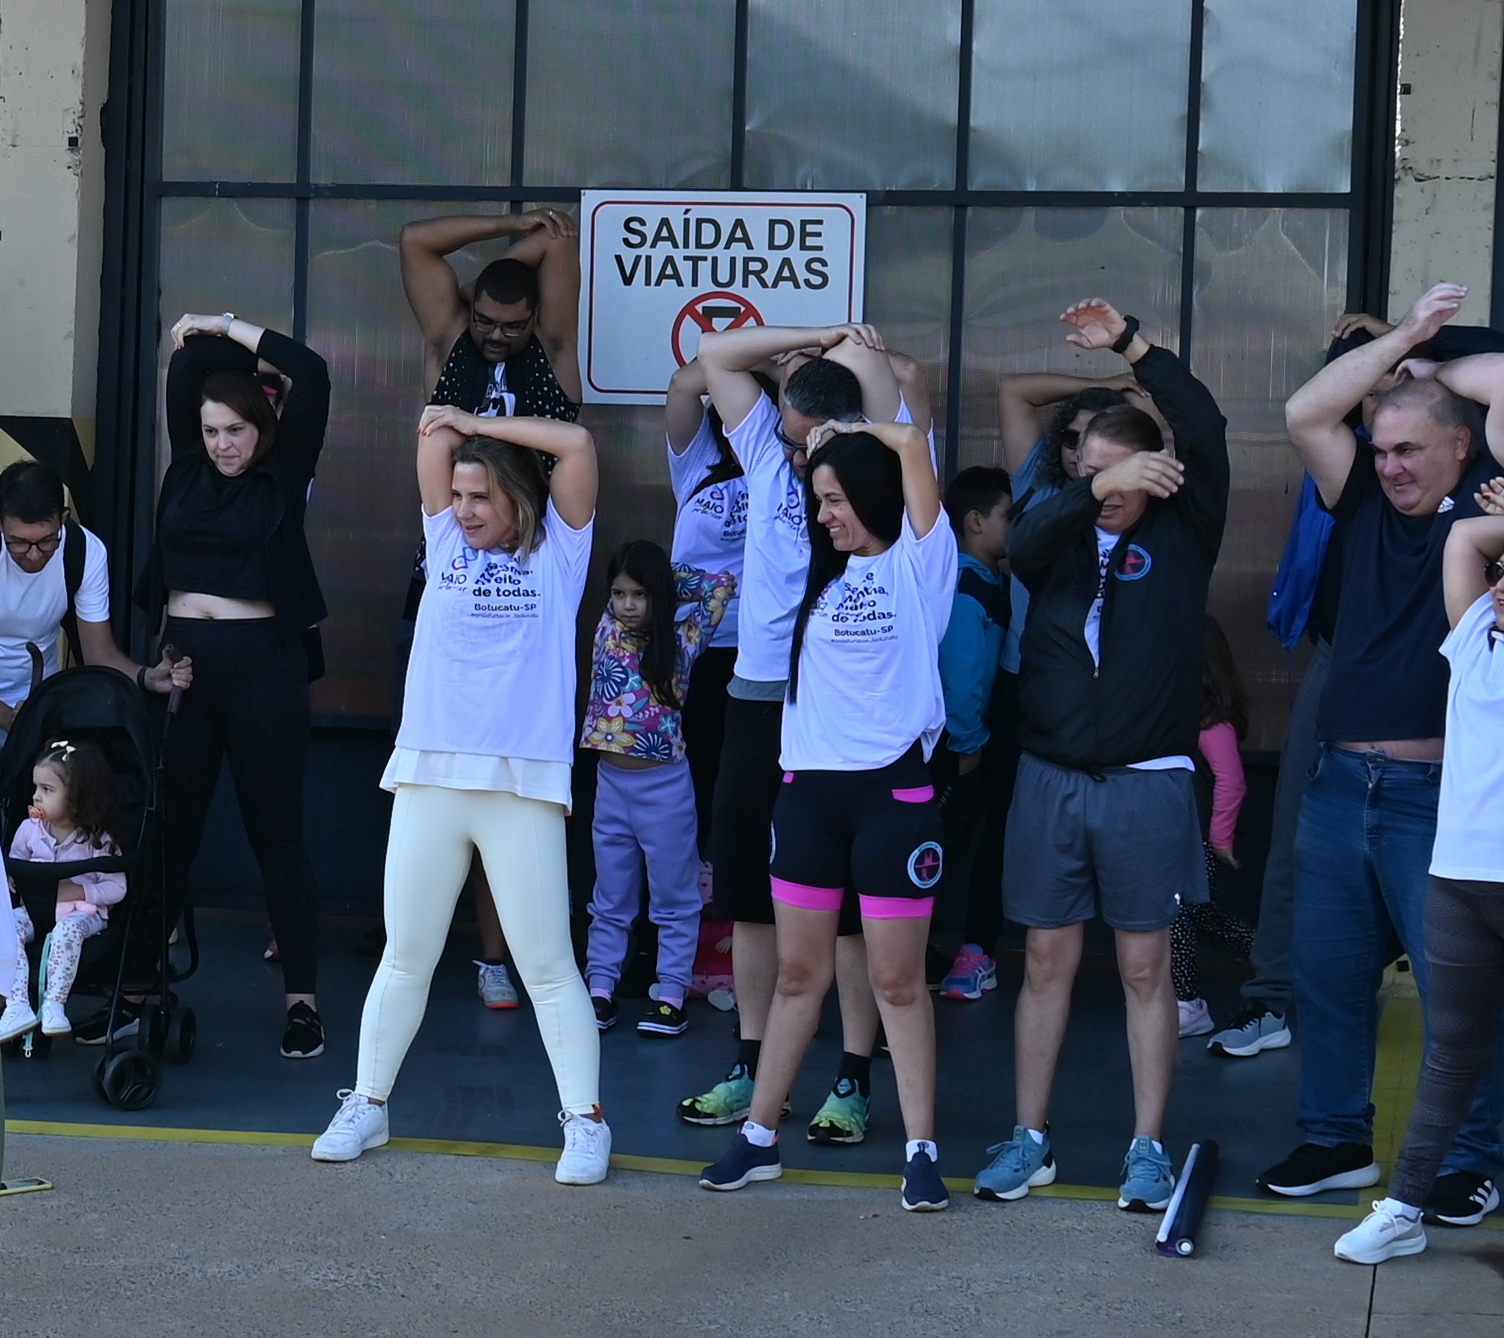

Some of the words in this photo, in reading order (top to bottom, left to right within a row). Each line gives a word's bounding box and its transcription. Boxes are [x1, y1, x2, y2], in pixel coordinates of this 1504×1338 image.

[621, 208, 755, 250] SAÍDA
[767, 218, 824, 252] DE
[613, 254, 830, 290] VIATURAS
[472, 586, 492, 597] de
[496, 586, 541, 598] todas.
[474, 603, 537, 612] Botucatu-SP
[831, 612, 849, 623] de
[834, 625, 894, 637] Botucatu-SP
